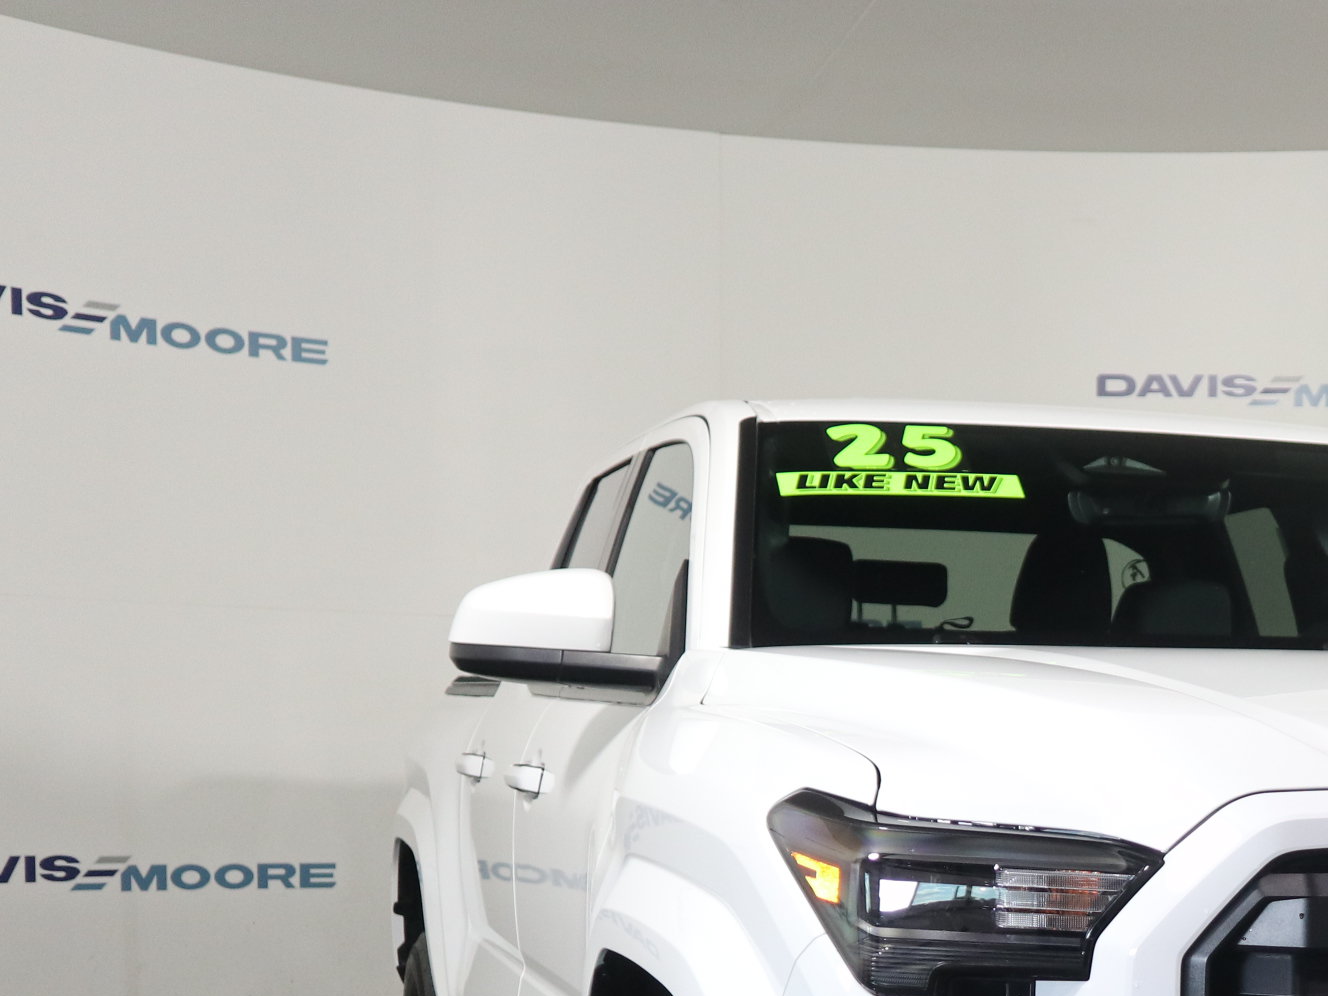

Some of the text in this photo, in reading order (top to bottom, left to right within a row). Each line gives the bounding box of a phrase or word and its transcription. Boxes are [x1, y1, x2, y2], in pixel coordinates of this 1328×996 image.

[109, 313, 329, 365] MOORE
[1096, 373, 1257, 398] DAVIS
[825, 423, 963, 470] 25
[796, 472, 1003, 494] LIKE NEW
[120, 862, 337, 892] MOORE
